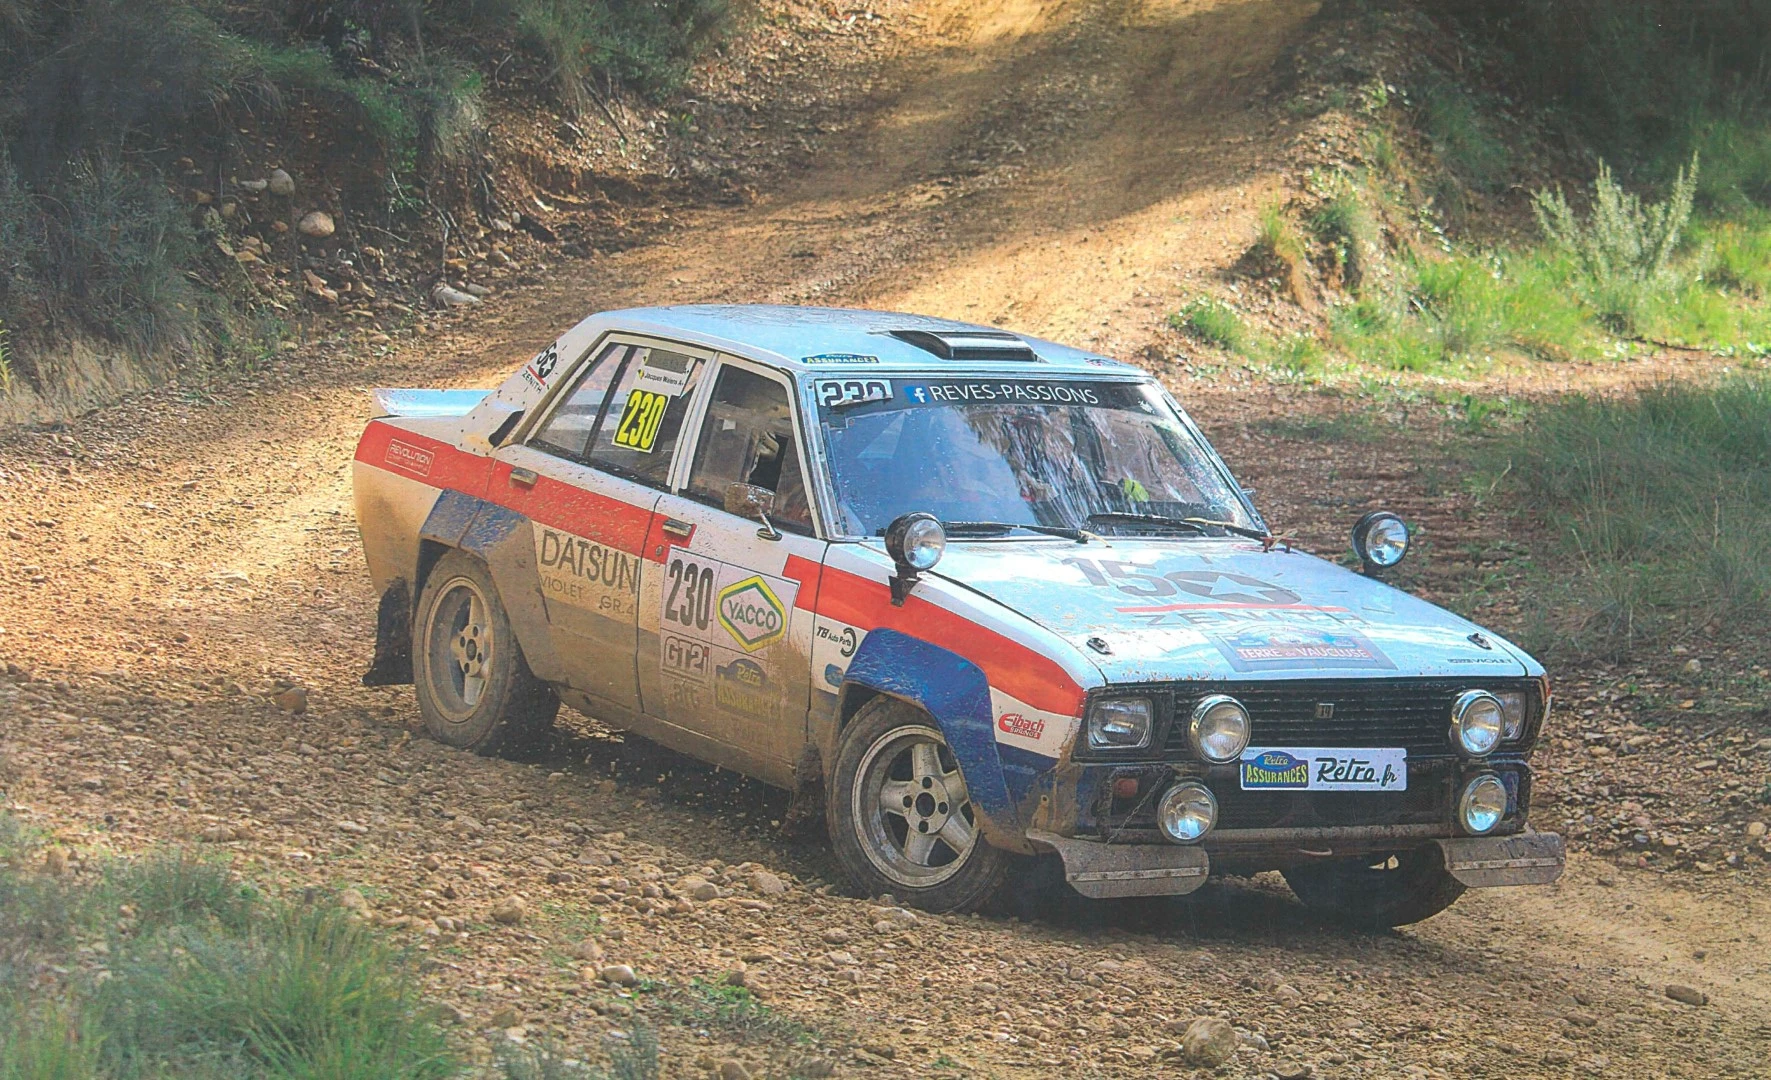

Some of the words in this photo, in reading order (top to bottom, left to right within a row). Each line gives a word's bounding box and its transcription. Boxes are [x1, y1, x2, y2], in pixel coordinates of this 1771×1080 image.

[806, 356, 877, 364] ASSURANCES
[521, 370, 542, 394] ZENITH
[929, 384, 1099, 404] REVES-PASSIONS
[616, 390, 666, 449] 230
[390, 443, 431, 465] REVOLUTION
[540, 529, 639, 595] DATSUN
[540, 576, 582, 599] VIOLET
[665, 559, 713, 631] 230
[728, 599, 777, 631] YACCO
[1134, 611, 1370, 627] ZENITH
[816, 626, 829, 638] TB
[828, 633, 839, 643] Auto
[839, 636, 852, 647] Parts
[1237, 647, 1282, 659] TERRE
[1299, 647, 1369, 659] VAUCLUSE
[998, 713, 1045, 733] Eibach
[1246, 764, 1308, 783] ASSURANCES
